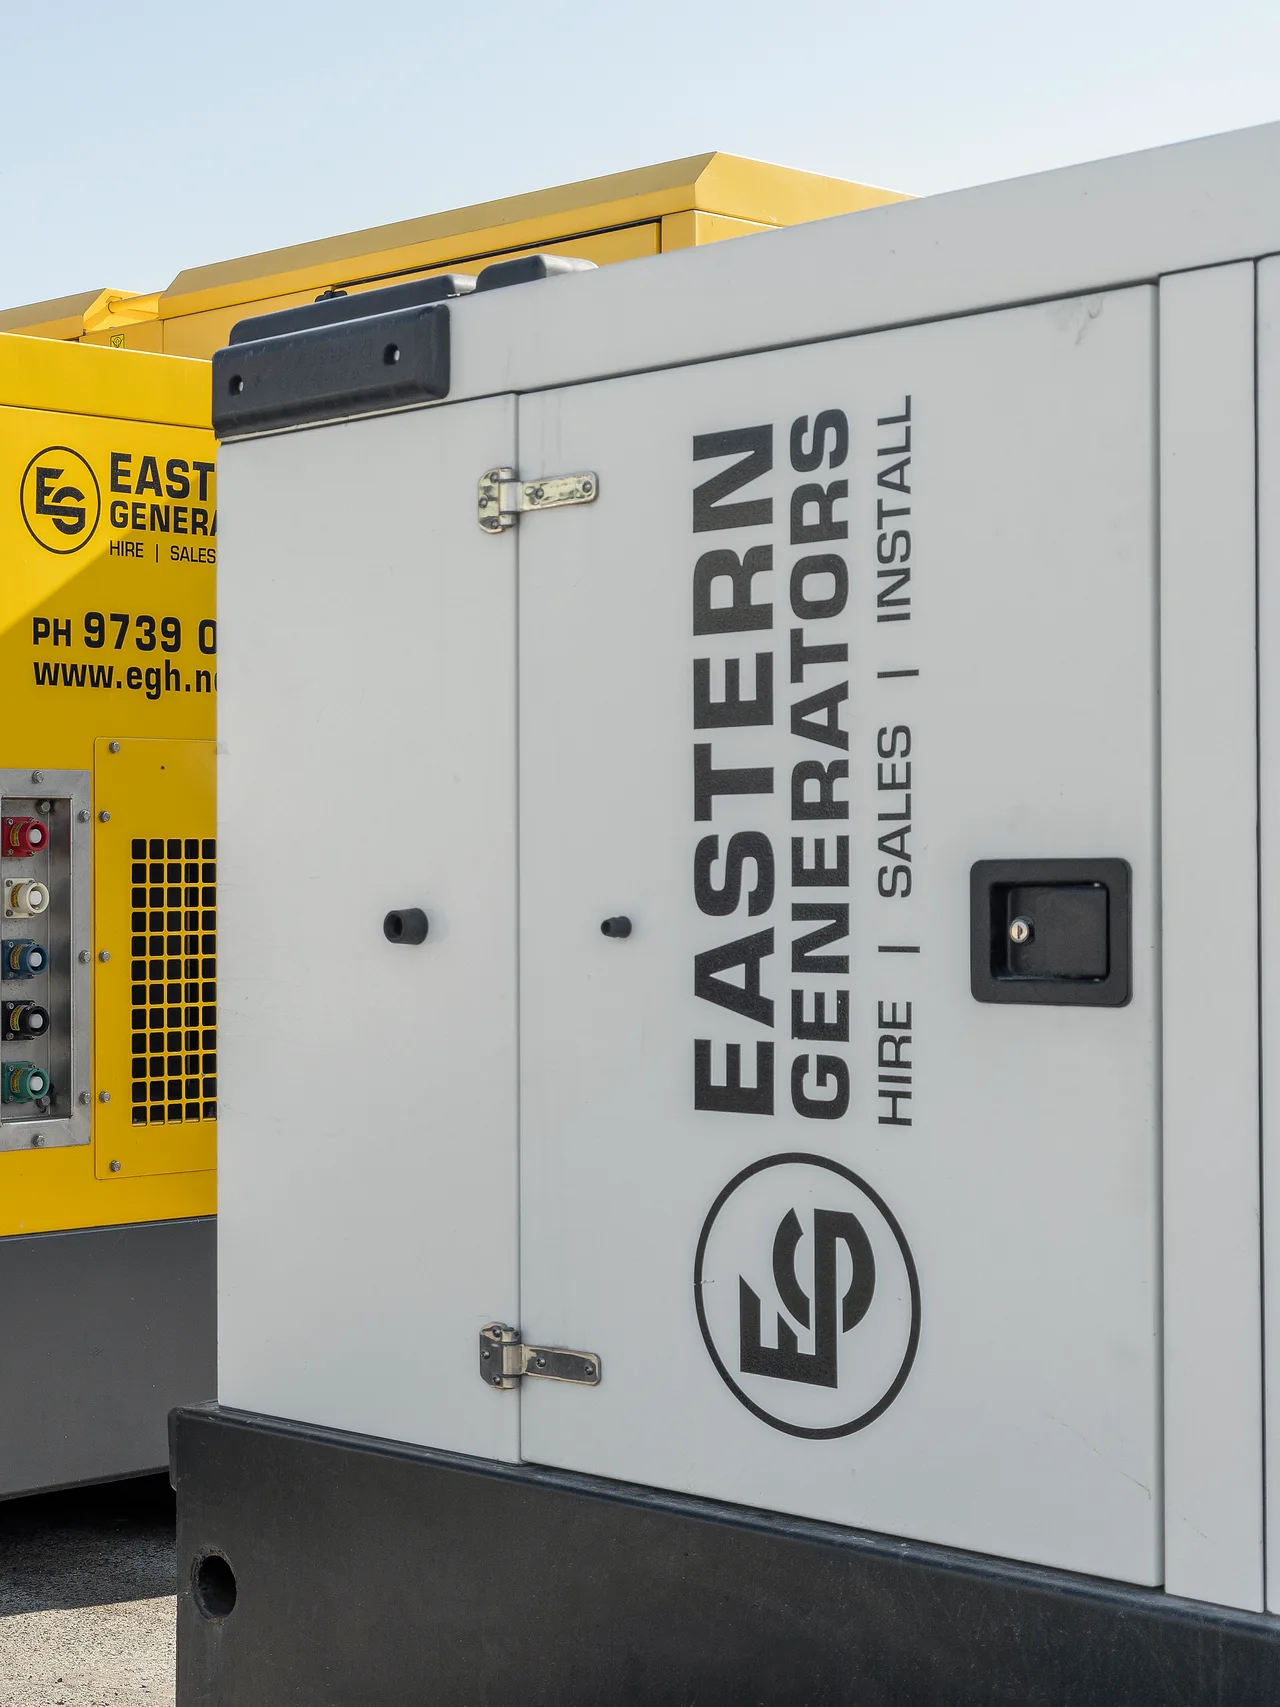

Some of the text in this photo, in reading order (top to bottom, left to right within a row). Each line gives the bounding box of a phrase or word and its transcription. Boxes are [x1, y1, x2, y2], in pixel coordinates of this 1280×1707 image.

[109, 539, 144, 558] HIRE
[170, 545, 217, 564] SALES
[877, 394, 912, 623] INSTALL
[32, 616, 71, 647] PH
[83, 611, 182, 653] 9739
[33, 658, 218, 700] www.egh.n
[693, 423, 774, 1115] EASTERN
[790, 408, 849, 1120] GENERATORS
[876, 724, 912, 898] SALES
[877, 1000, 912, 1126] HIRE
